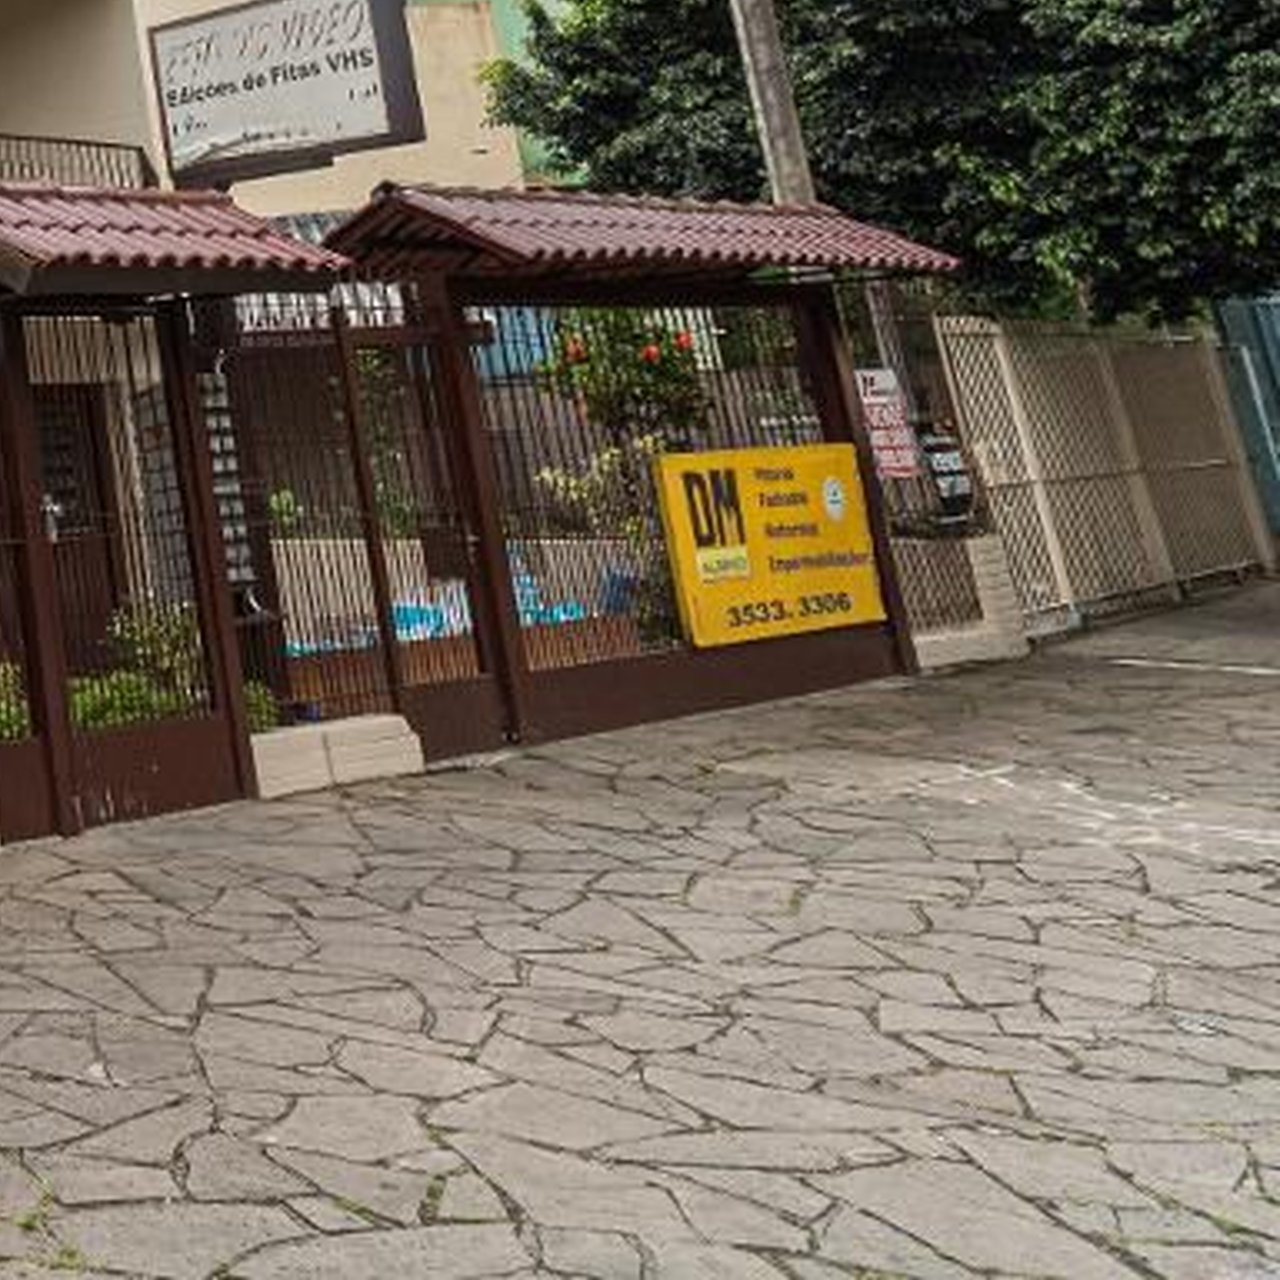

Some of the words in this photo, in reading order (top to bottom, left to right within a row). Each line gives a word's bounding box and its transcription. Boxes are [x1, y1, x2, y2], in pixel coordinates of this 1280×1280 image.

[242, 71, 267, 92] de
[270, 61, 323, 87] Fitas
[326, 48, 375, 74] VHS
[682, 467, 747, 549] DM
